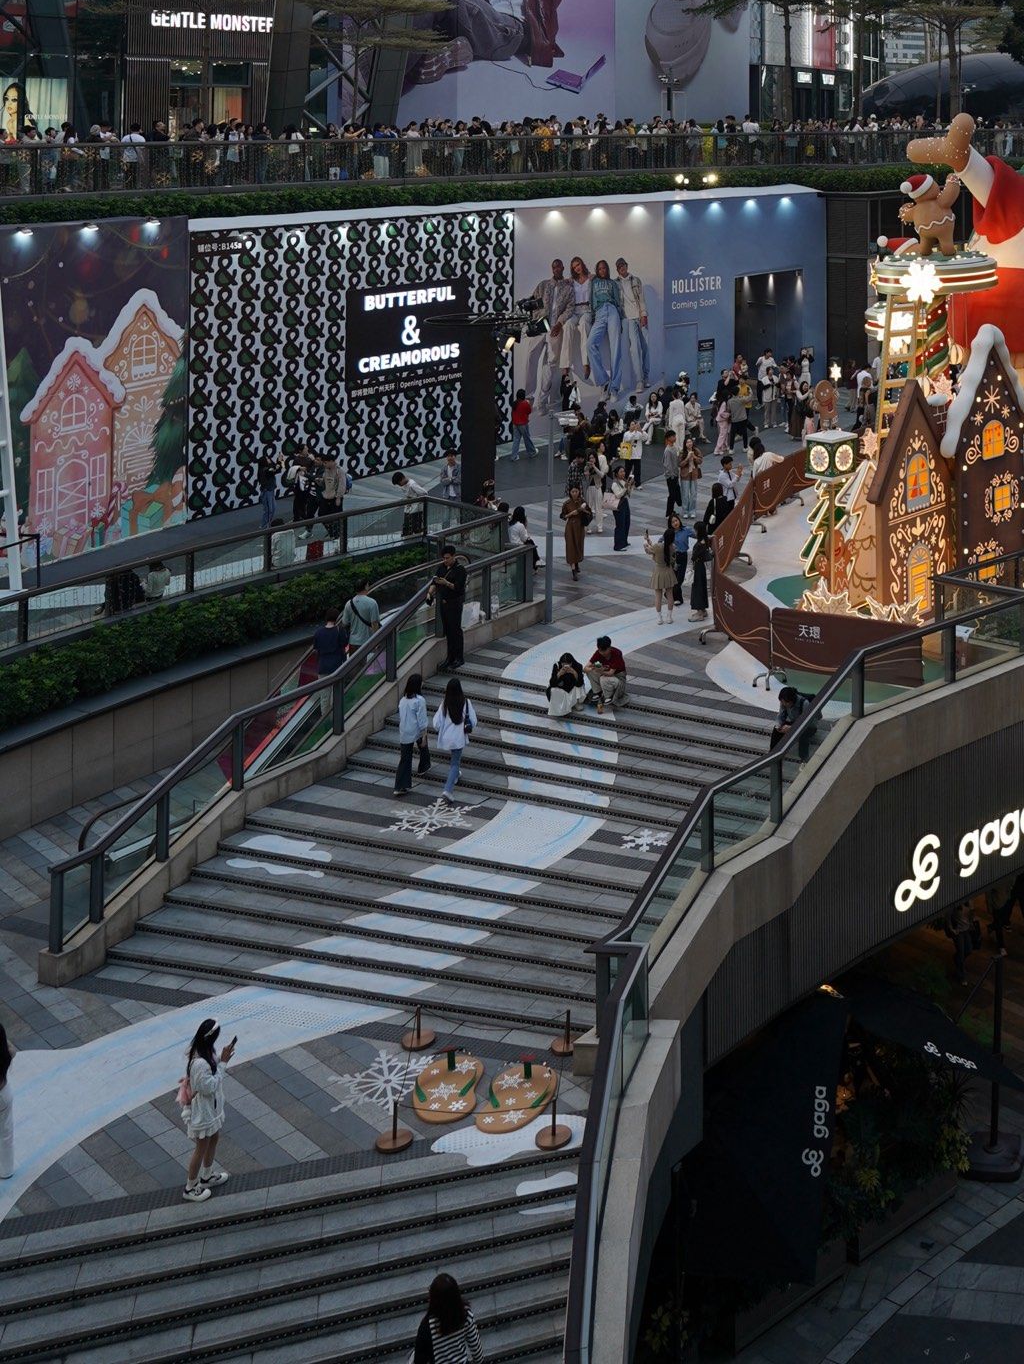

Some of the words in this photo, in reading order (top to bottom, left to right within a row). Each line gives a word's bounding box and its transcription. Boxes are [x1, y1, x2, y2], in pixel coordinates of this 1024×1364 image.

[151, 10, 206, 28] GENTLE
[671, 276, 721, 294] HOLLISTER
[364, 286, 456, 311] BUTTERFUL
[672, 300, 697, 310] Coming
[700, 298, 717, 307] Soon
[401, 315, 421, 345] &
[358, 343, 460, 373] CREAMOROUS
[400, 379, 422, 388] Opening
[438, 374, 448, 382] stay
[798, 624, 820, 639] 天環
[945, 1052, 978, 1069] gaga
[813, 1086, 830, 1139] gaga
